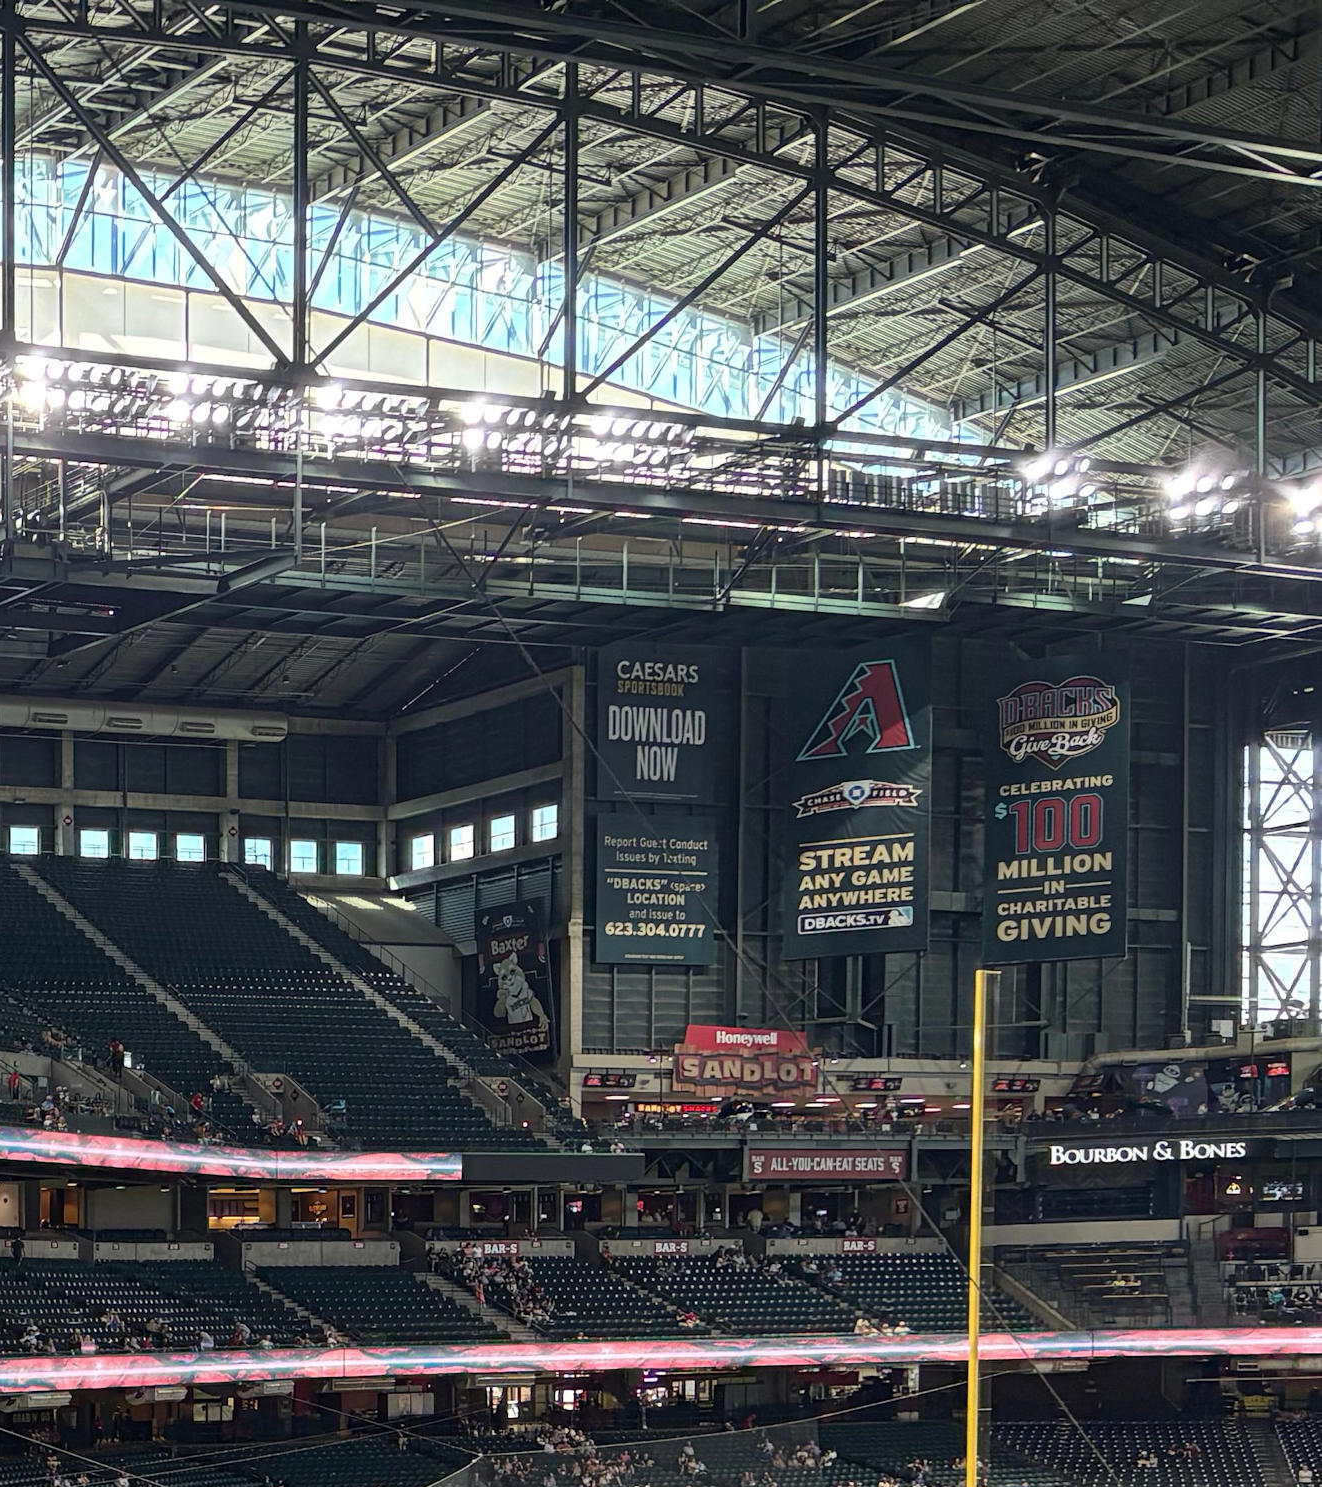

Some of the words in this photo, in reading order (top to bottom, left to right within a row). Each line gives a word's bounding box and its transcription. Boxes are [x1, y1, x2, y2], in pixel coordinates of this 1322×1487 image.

[617, 661, 698, 683] CAESARS
[618, 680, 684, 696] SPORTSBOOK
[608, 705, 706, 745] DOWNLOAD
[1009, 734, 1052, 760] Give
[1047, 727, 1103, 755] Back
[637, 745, 677, 781] NOW
[999, 774, 1114, 797] CELEBRATING
[807, 793, 841, 807] CHASE
[872, 787, 908, 798] FIELD
[994, 793, 1104, 855] $100
[604, 836, 636, 849] Report
[670, 839, 708, 851] Conduct
[616, 851, 646, 863] Issues
[648, 852, 660, 865] by
[799, 842, 914, 871] STREAM
[997, 851, 1113, 880] MILLION
[798, 872, 846, 892] ANY
[851, 866, 914, 886] GAME
[1043, 879, 1065, 895] IN
[627, 893, 685, 906] LOCATION
[798, 886, 914, 910] ANYWHERE
[997, 894, 1112, 916] CHARITABLE
[629, 909, 646, 919] and
[649, 909, 673, 920] issue
[675, 910, 686, 920] to
[804, 913, 886, 931] DBACKS.TV
[604, 922, 706, 938] 623.304.0777
[996, 912, 1112, 943] GIVING
[490, 935, 529, 957] Baxter
[716, 1030, 778, 1047] Honeywell
[683, 1057, 814, 1083] SANDLOT
[1152, 1142, 1175, 1162] &
[770, 1157, 853, 1172] ALL-YOU-CAN-EAT
[855, 1156, 885, 1171] SEATS
[484, 1243, 517, 1254] BAR-S
[655, 1242, 687, 1253] BAR-S
[843, 1241, 875, 1251] BAR-S
